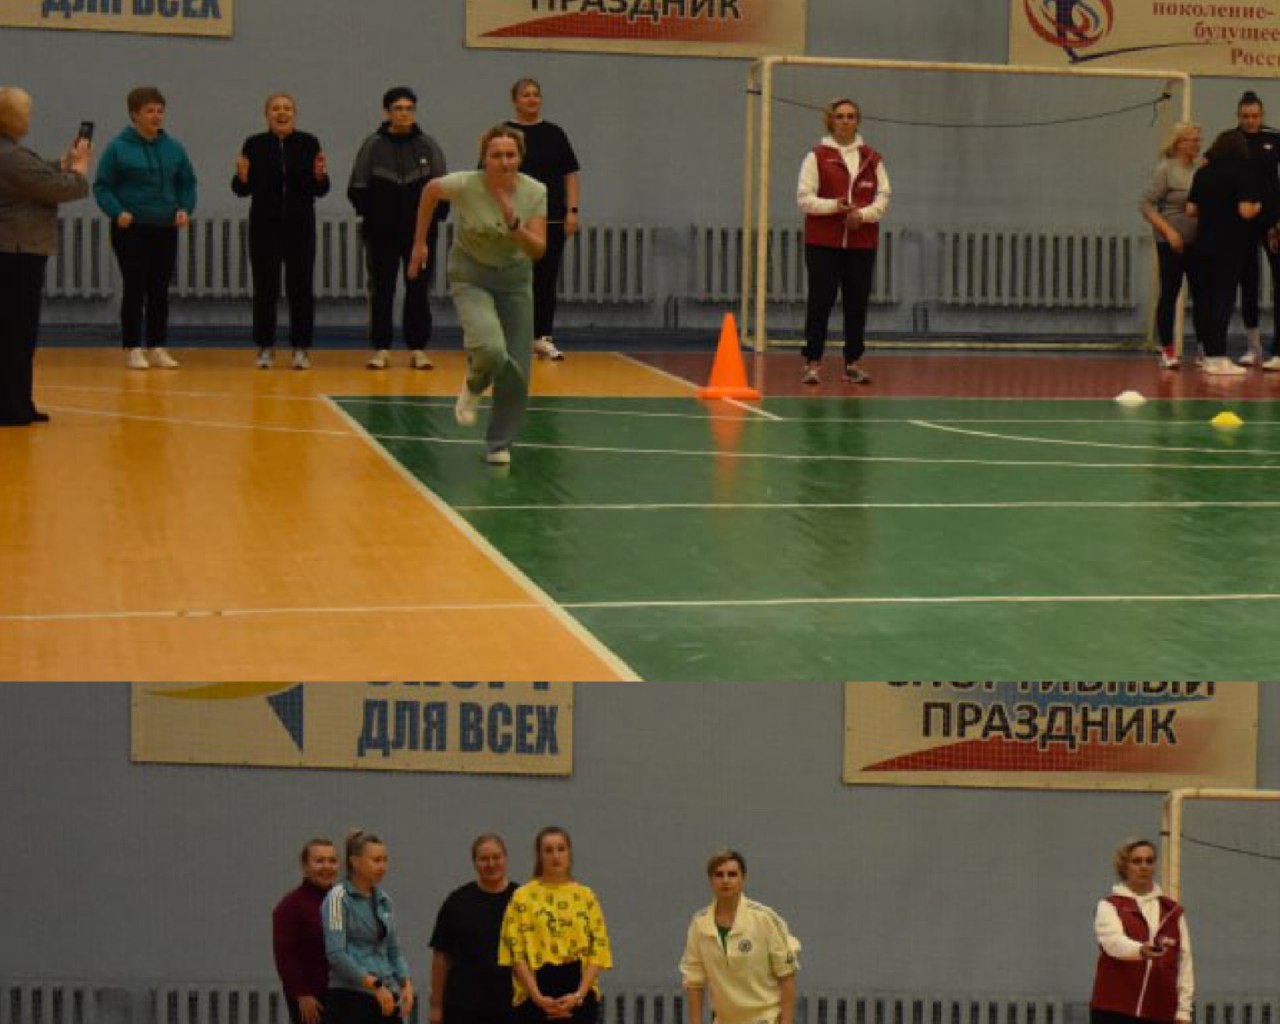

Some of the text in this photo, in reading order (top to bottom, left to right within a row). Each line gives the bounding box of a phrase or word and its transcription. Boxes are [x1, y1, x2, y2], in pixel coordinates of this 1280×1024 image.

[1152, 2, 1275, 19] поколение-
[1193, 21, 1280, 44] будущее
[357, 699, 559, 757] ДЛЯ ВСЕХ
[922, 701, 1177, 750] ПРАЗДНИК
